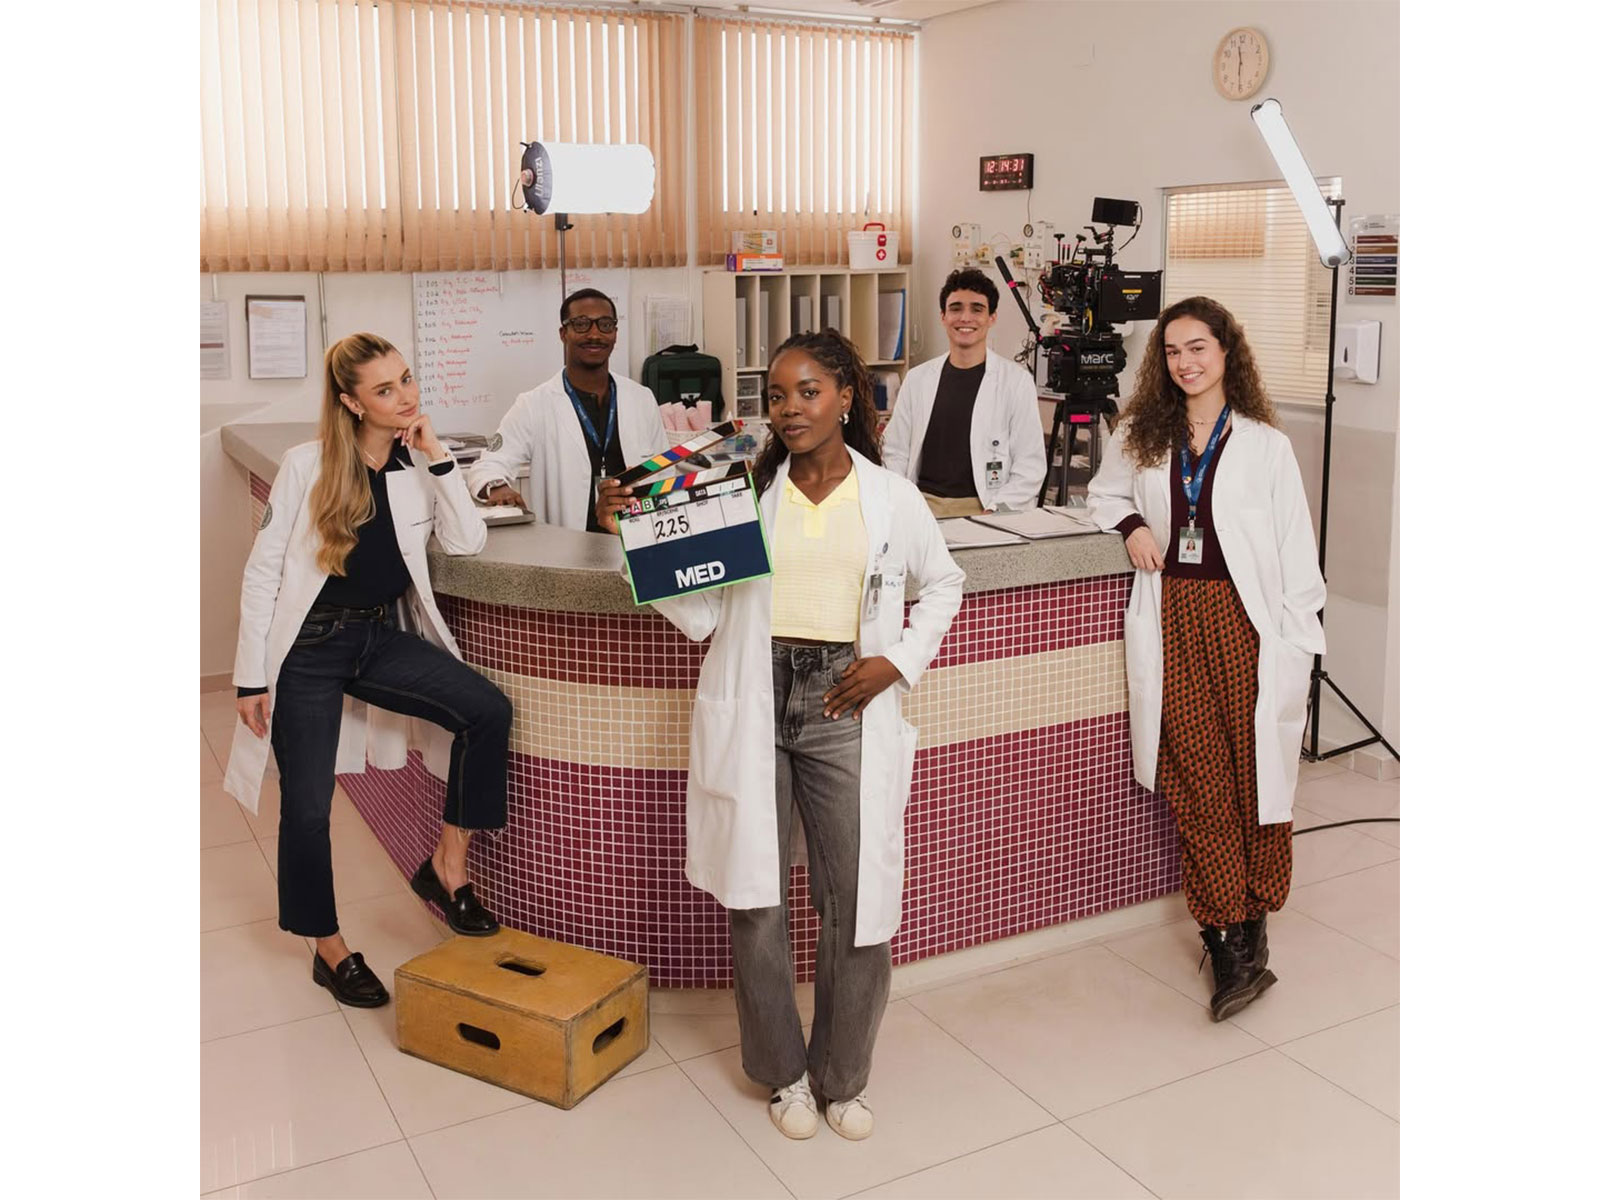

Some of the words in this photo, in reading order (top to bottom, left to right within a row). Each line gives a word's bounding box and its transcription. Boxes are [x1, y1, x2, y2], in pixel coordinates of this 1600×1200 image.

[633, 500, 641, 511] A
[643, 499, 652, 510] B
[674, 560, 726, 589] MED
